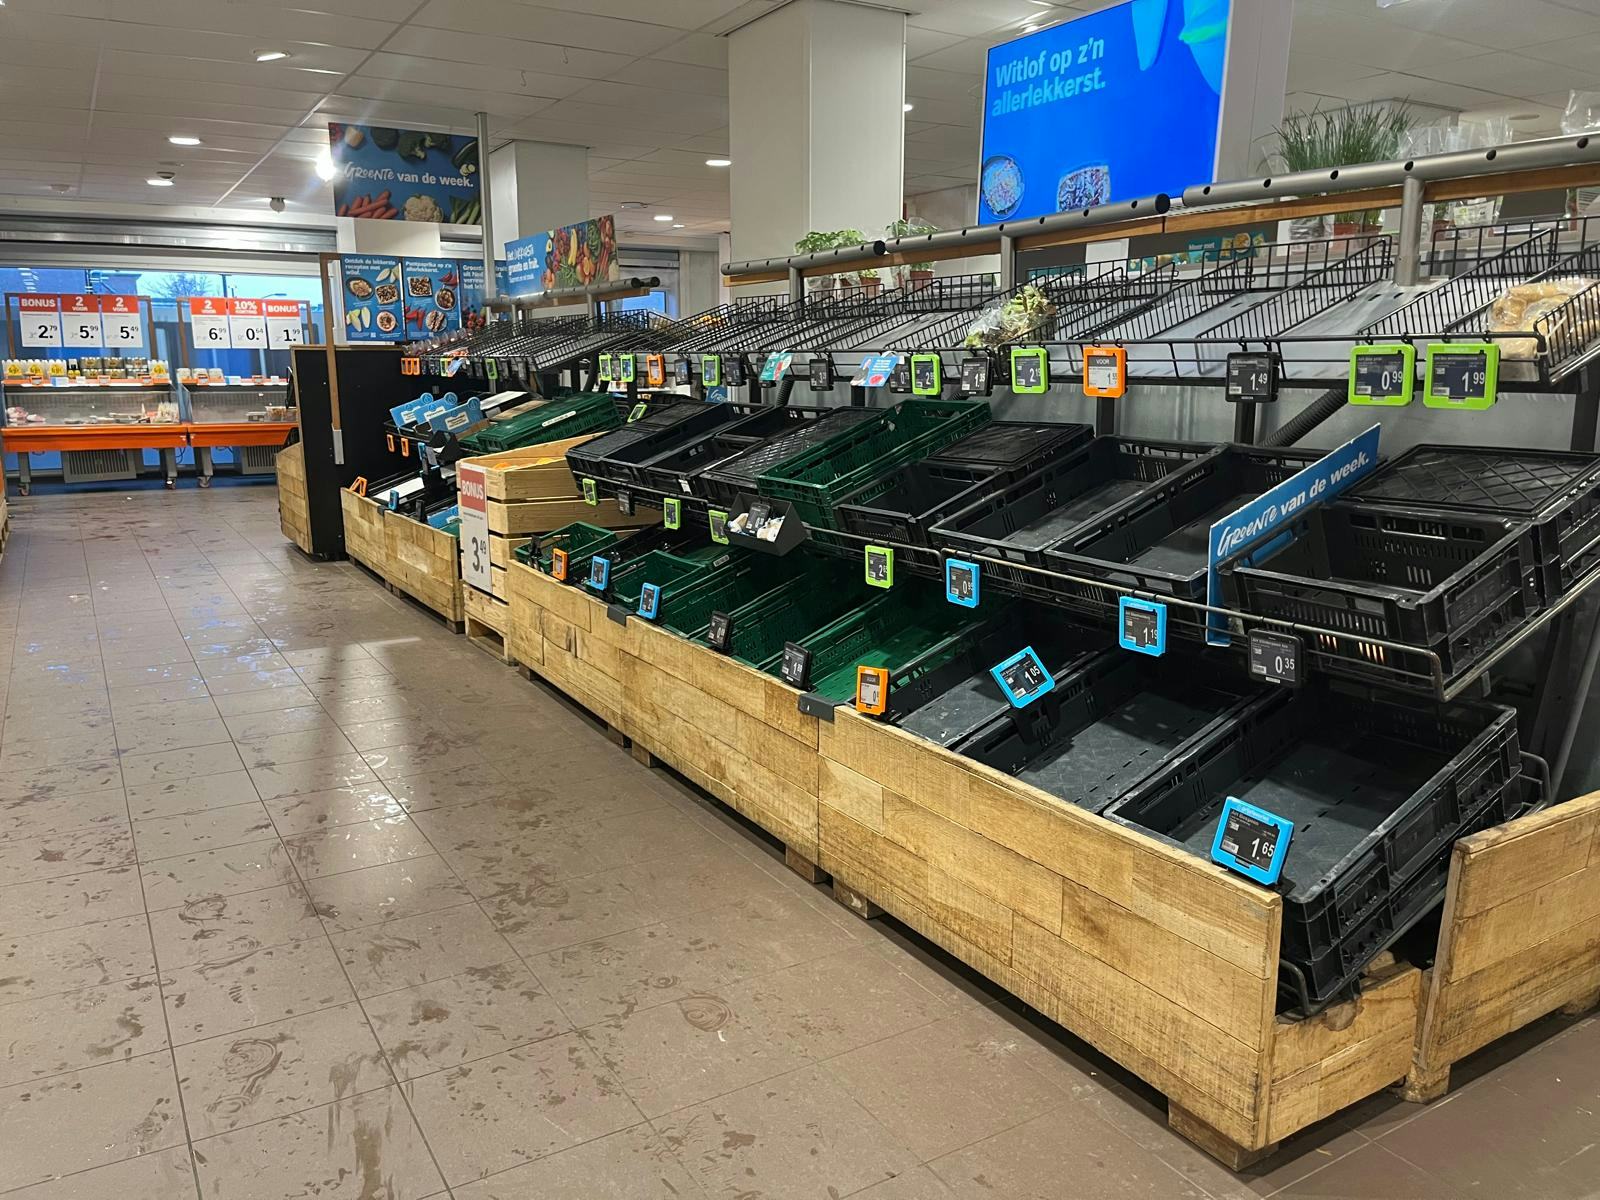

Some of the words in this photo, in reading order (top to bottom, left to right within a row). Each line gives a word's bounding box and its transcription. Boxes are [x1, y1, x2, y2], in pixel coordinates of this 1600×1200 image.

[996, 50, 1046, 88] Witlof
[1049, 49, 1072, 75] op
[991, 67, 1106, 116] allerlekkerst.
[397, 173, 419, 183] van
[421, 172, 436, 184] de
[439, 174, 474, 187] week.
[21, 298, 56, 308] BONUS
[75, 296, 84, 307] 2
[115, 297, 124, 307] 2
[204, 300, 212, 309] 2
[234, 301, 257, 310] 10%
[267, 305, 298, 313] BONUS
[1280, 490, 1306, 516] van
[1309, 478, 1327, 498] de
[1330, 451, 1369, 485] week.
[461, 480, 484, 500] BONUS
